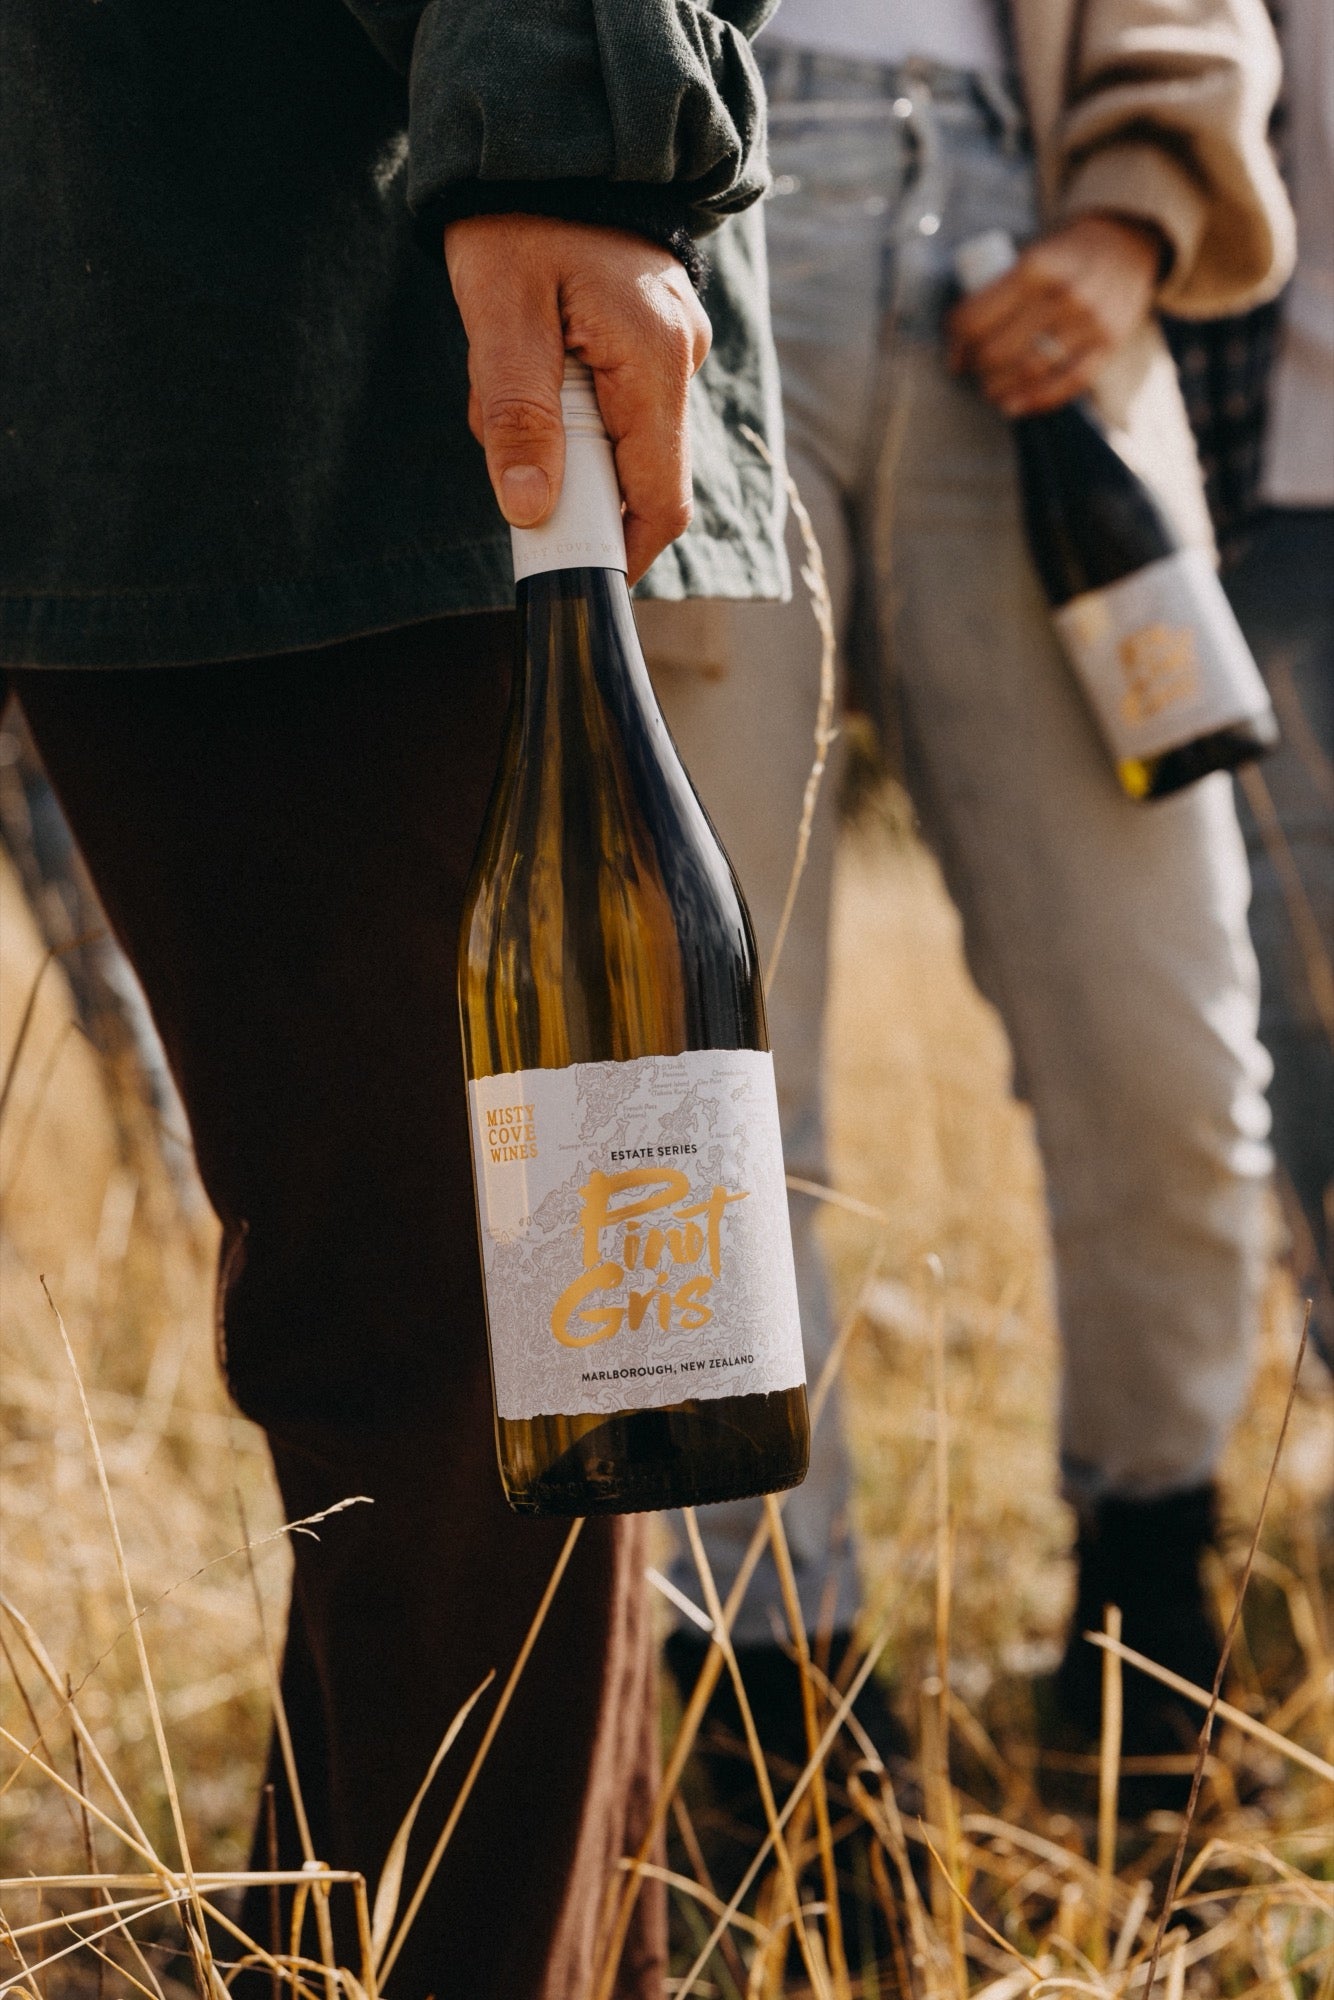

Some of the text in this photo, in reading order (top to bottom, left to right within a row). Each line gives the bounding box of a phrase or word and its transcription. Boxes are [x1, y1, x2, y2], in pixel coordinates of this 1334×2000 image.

[556, 542, 592, 554] COVE
[486, 1104, 536, 1127] MISTY
[488, 1124, 537, 1146] COVE
[490, 1142, 539, 1163] WINES
[611, 1144, 698, 1161] ESTATE SERIES
[575, 1168, 750, 1278] Pinot
[552, 1262, 714, 1348] Gris
[581, 1354, 755, 1382] MARLBOROUGH, NEW ZEALAND
